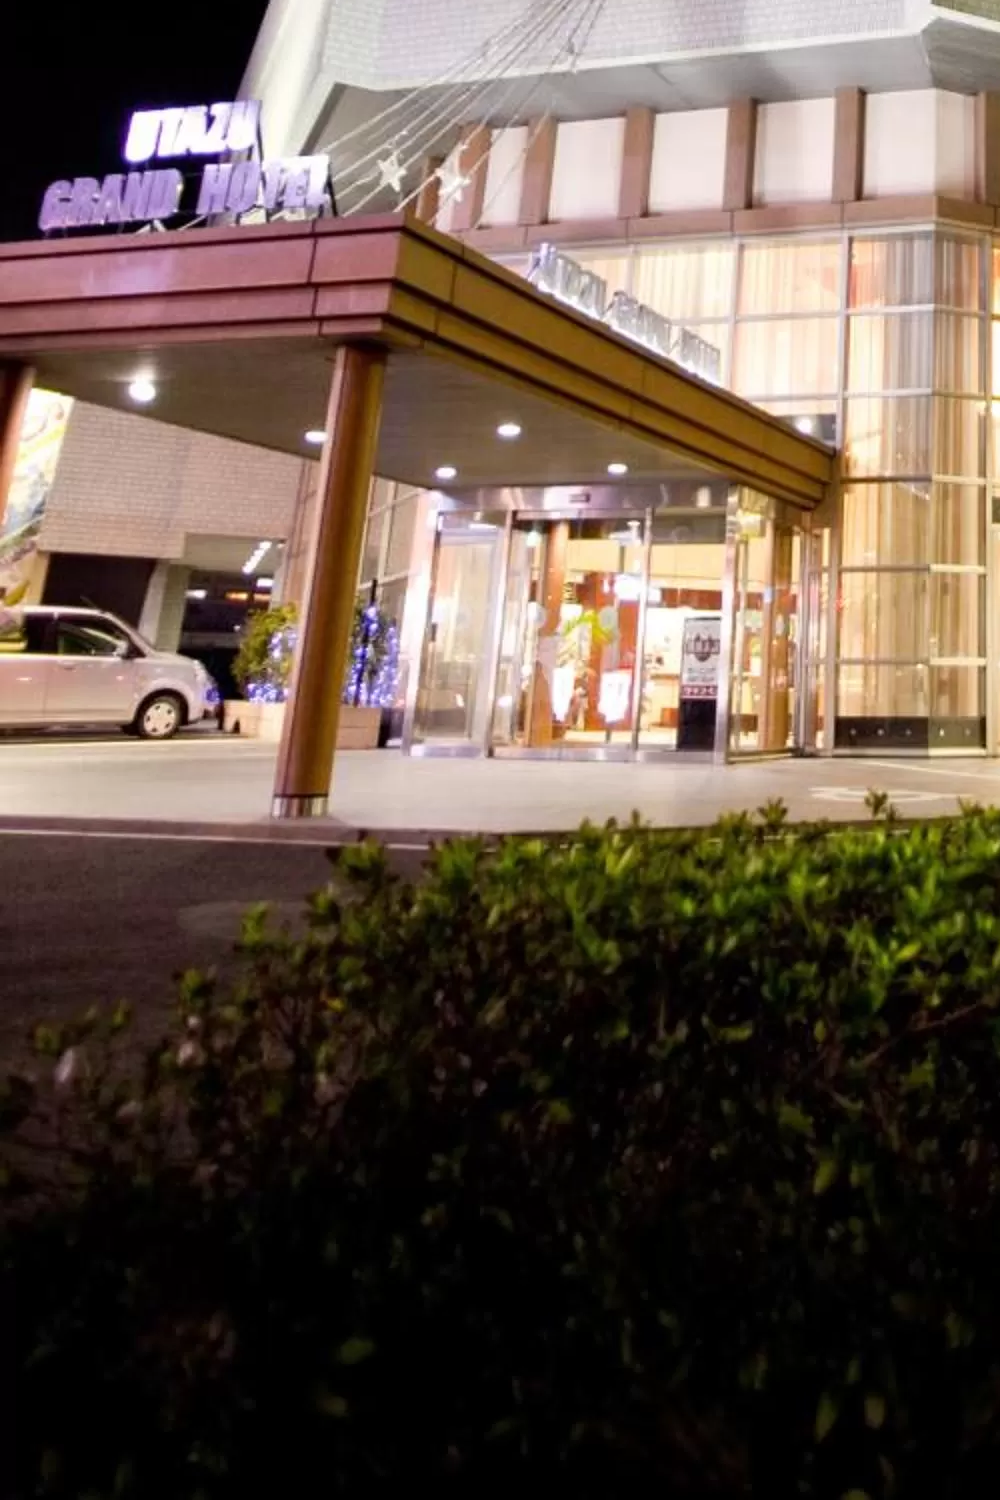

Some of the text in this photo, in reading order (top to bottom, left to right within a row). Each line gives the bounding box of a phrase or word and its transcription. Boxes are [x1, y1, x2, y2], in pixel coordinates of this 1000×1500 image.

[125, 101, 260, 163] UTAZU
[39, 155, 329, 230] GRAND HOTEL
